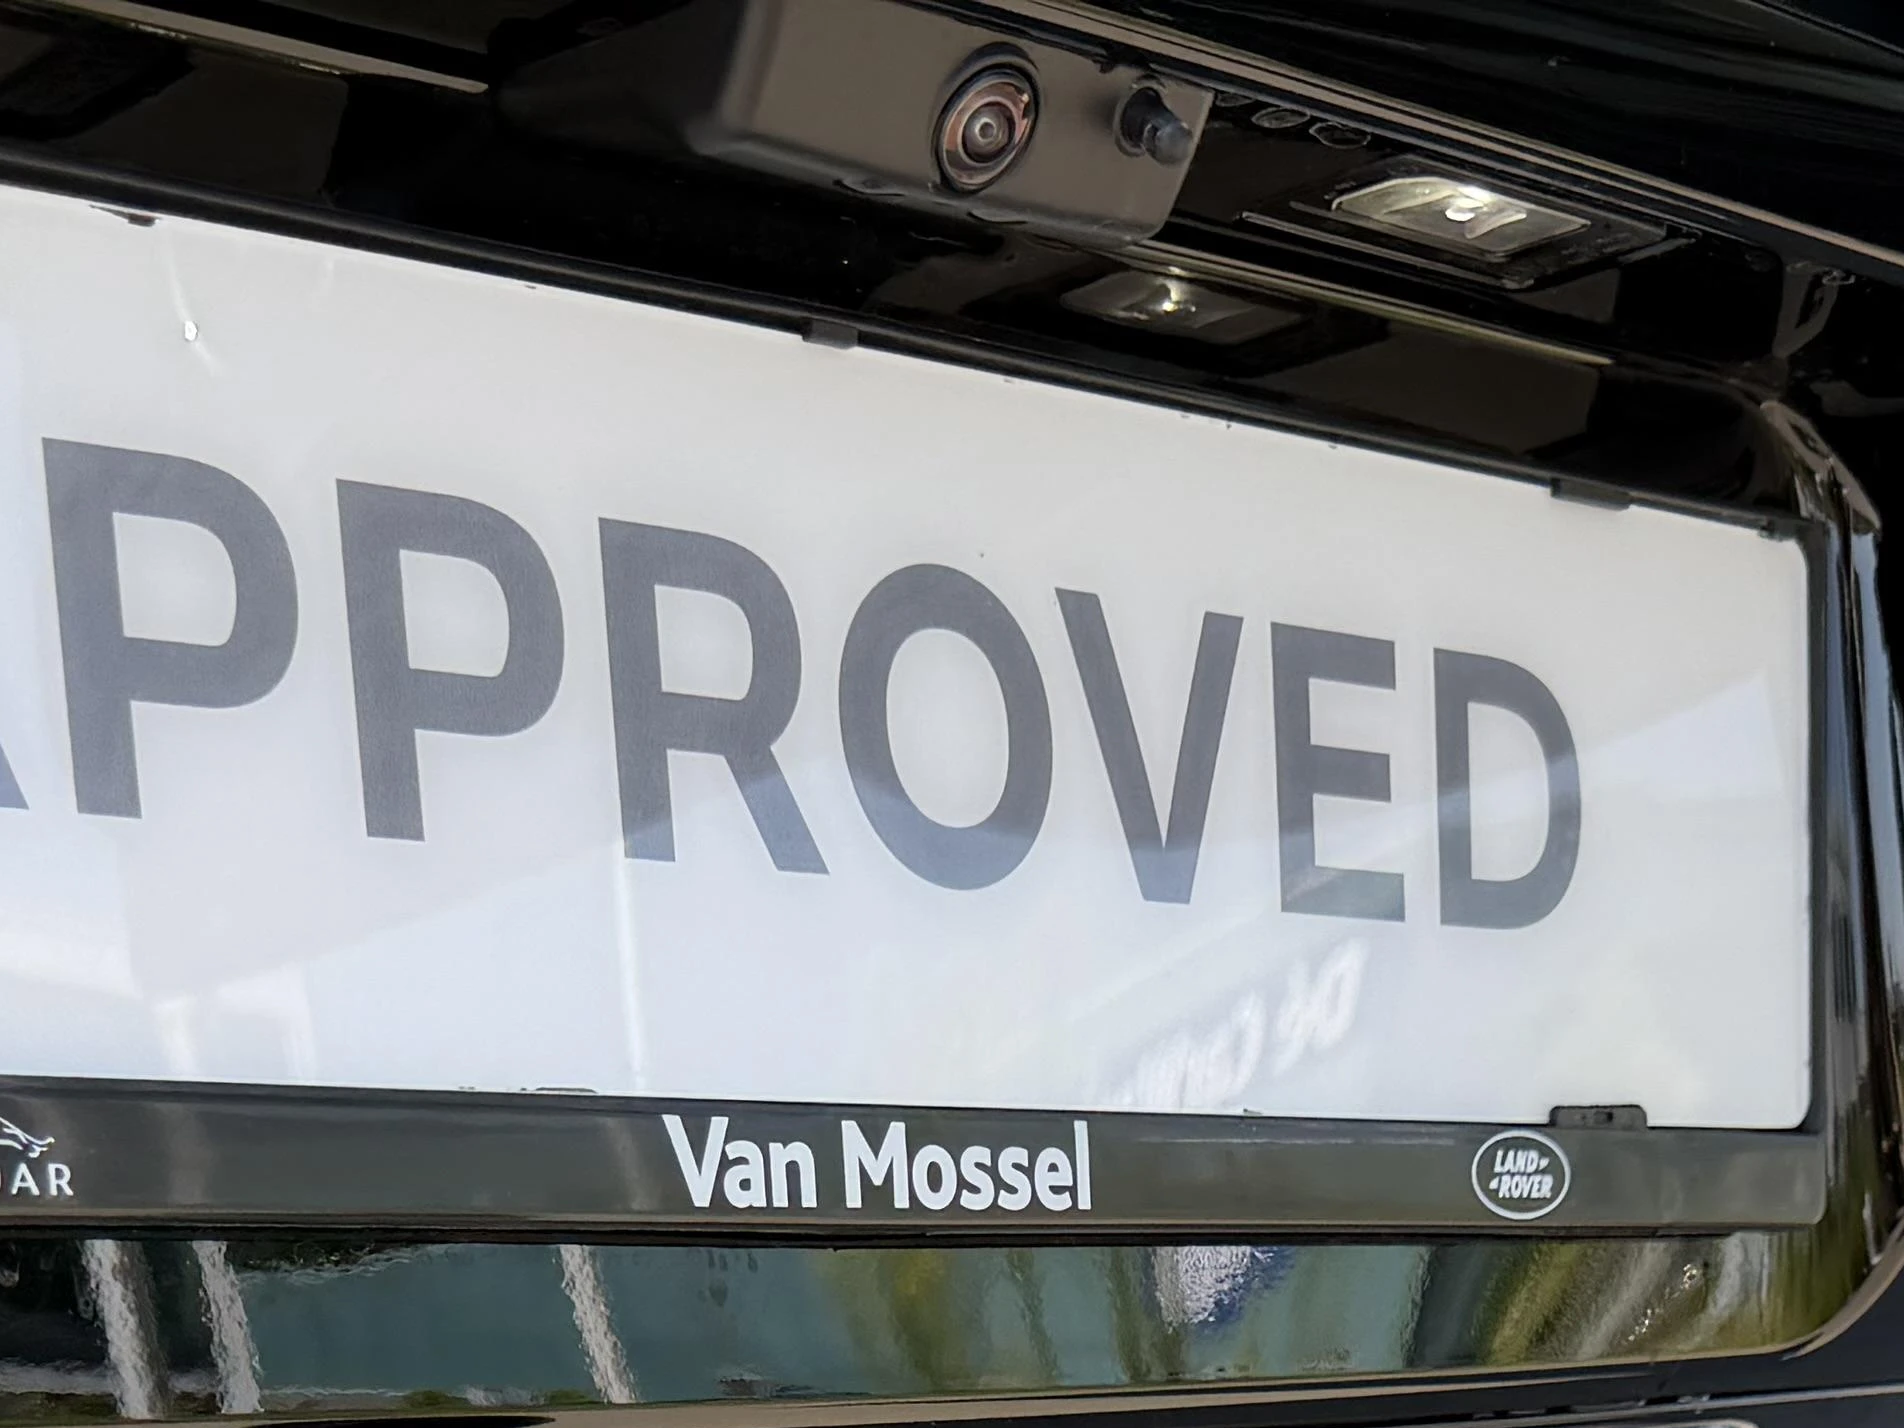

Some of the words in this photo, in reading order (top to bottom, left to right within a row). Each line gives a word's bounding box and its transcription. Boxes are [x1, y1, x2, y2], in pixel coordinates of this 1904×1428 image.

[661, 1113, 818, 1209] Van
[840, 1118, 1093, 1212] Mossel
[1493, 1148, 1540, 1173] LAND
[1498, 1173, 1555, 1199] ROVER
